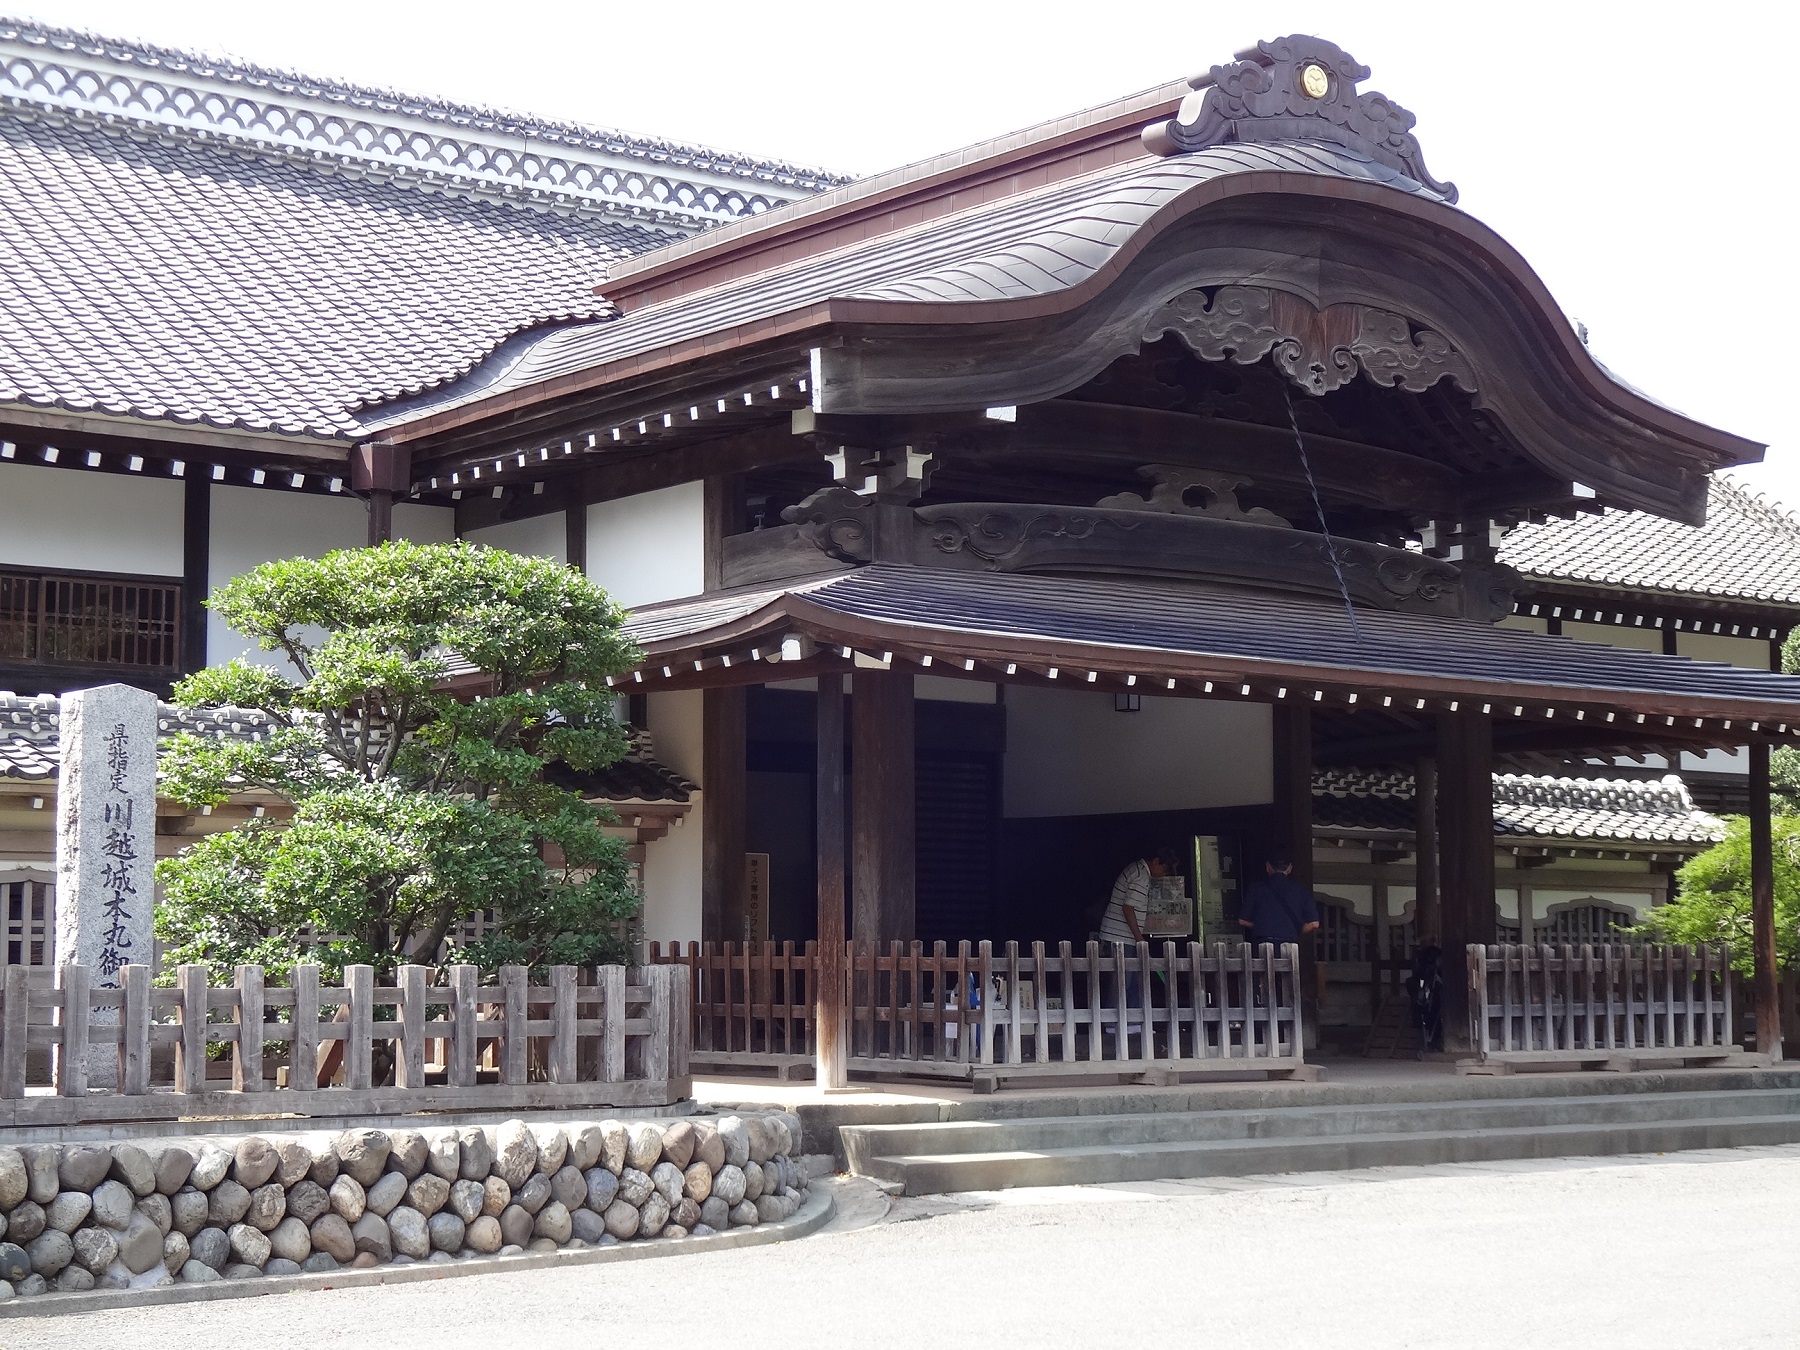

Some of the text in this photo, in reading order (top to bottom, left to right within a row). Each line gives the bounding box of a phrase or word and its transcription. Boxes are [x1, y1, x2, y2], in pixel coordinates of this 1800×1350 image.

[94, 723, 138, 1012] 県指定 川越城本丸御
